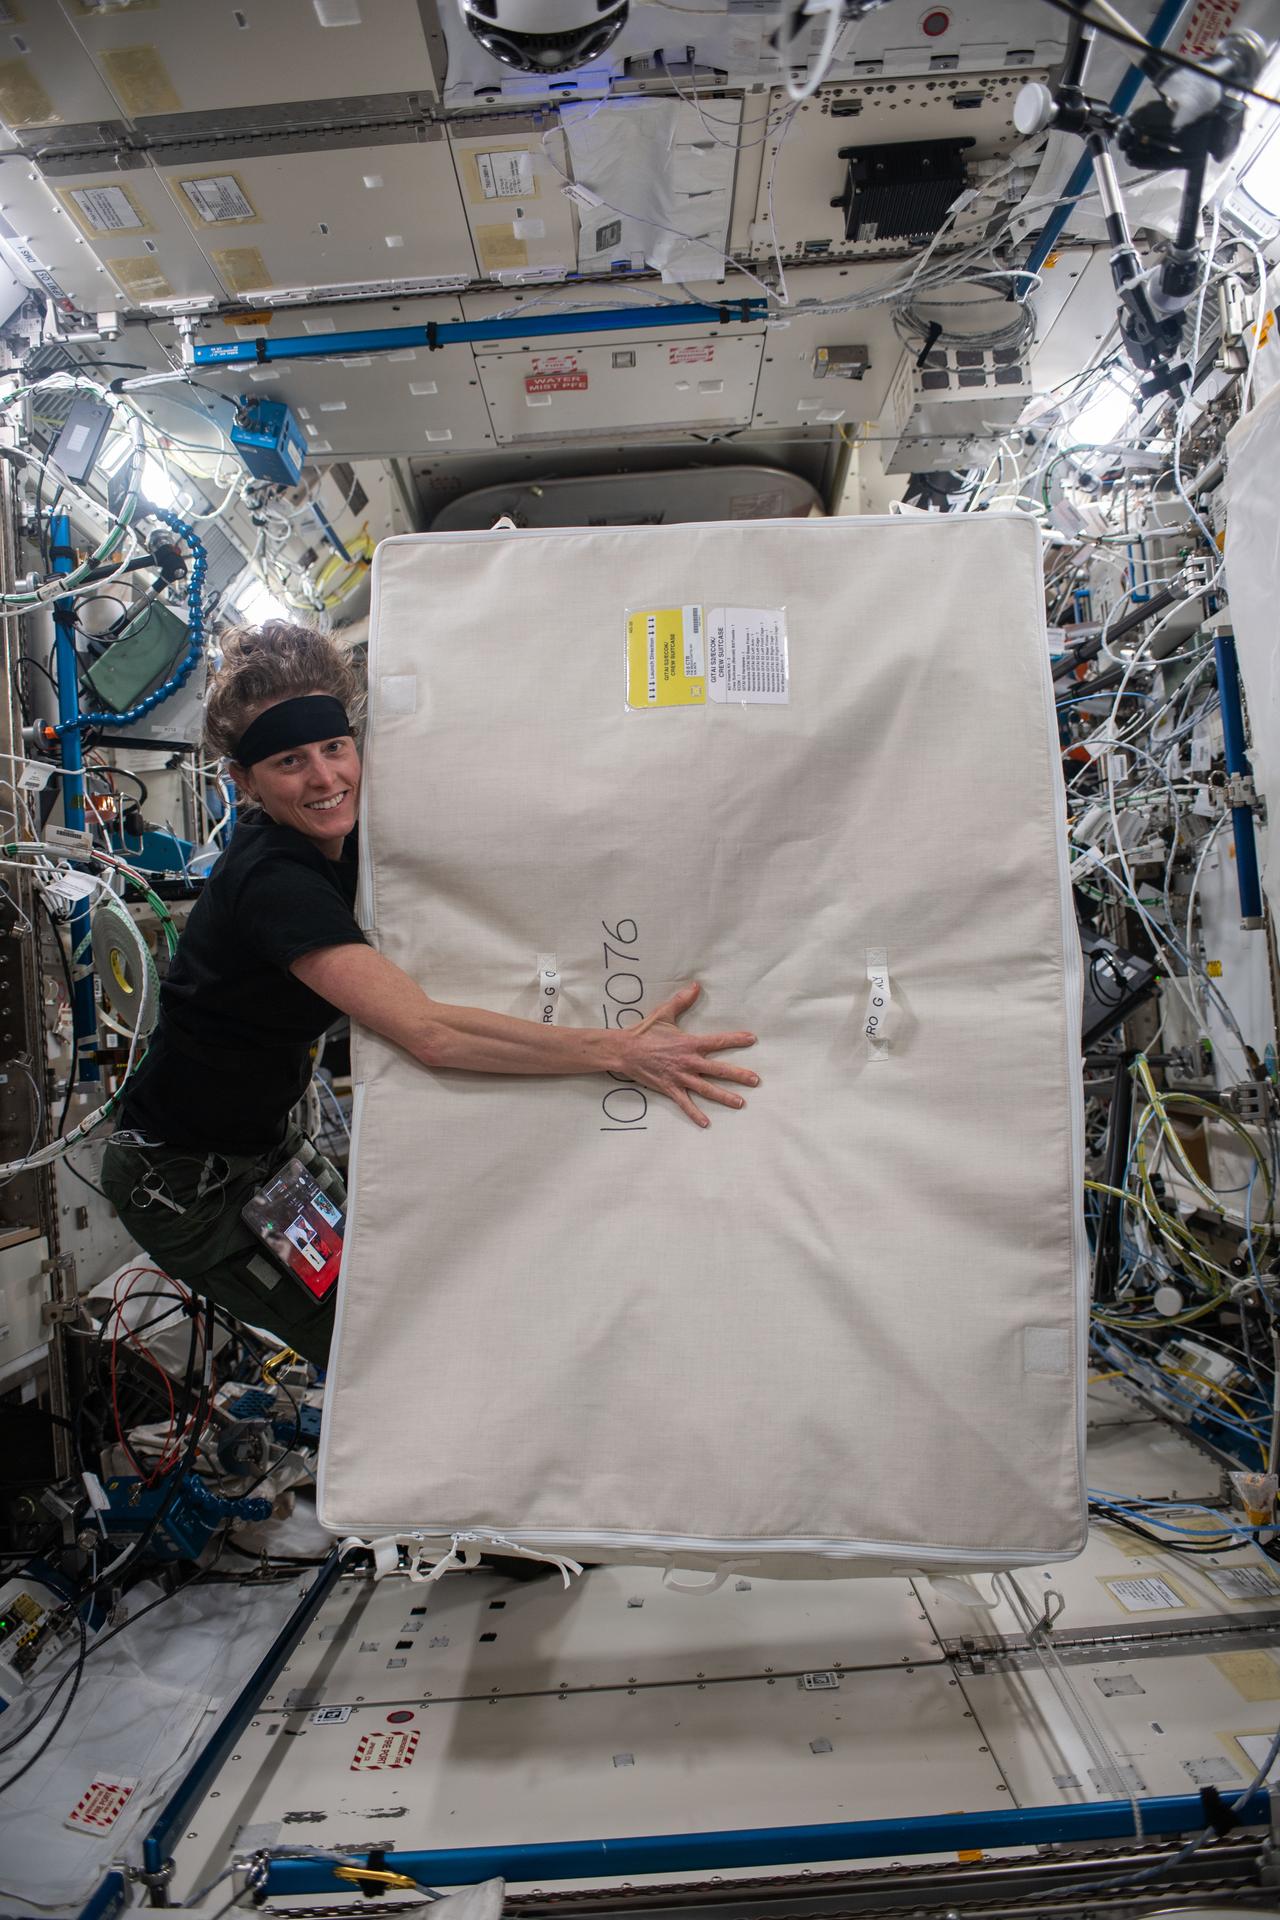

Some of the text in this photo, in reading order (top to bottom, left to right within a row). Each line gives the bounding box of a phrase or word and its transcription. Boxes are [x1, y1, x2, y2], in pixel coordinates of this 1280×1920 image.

[534, 376, 582, 385] WATER
[544, 986, 555, 996] G
[872, 997, 884, 1007] G
[600, 918, 648, 1131] 105076
[376, 1736, 394, 1764] FIRE PORT
